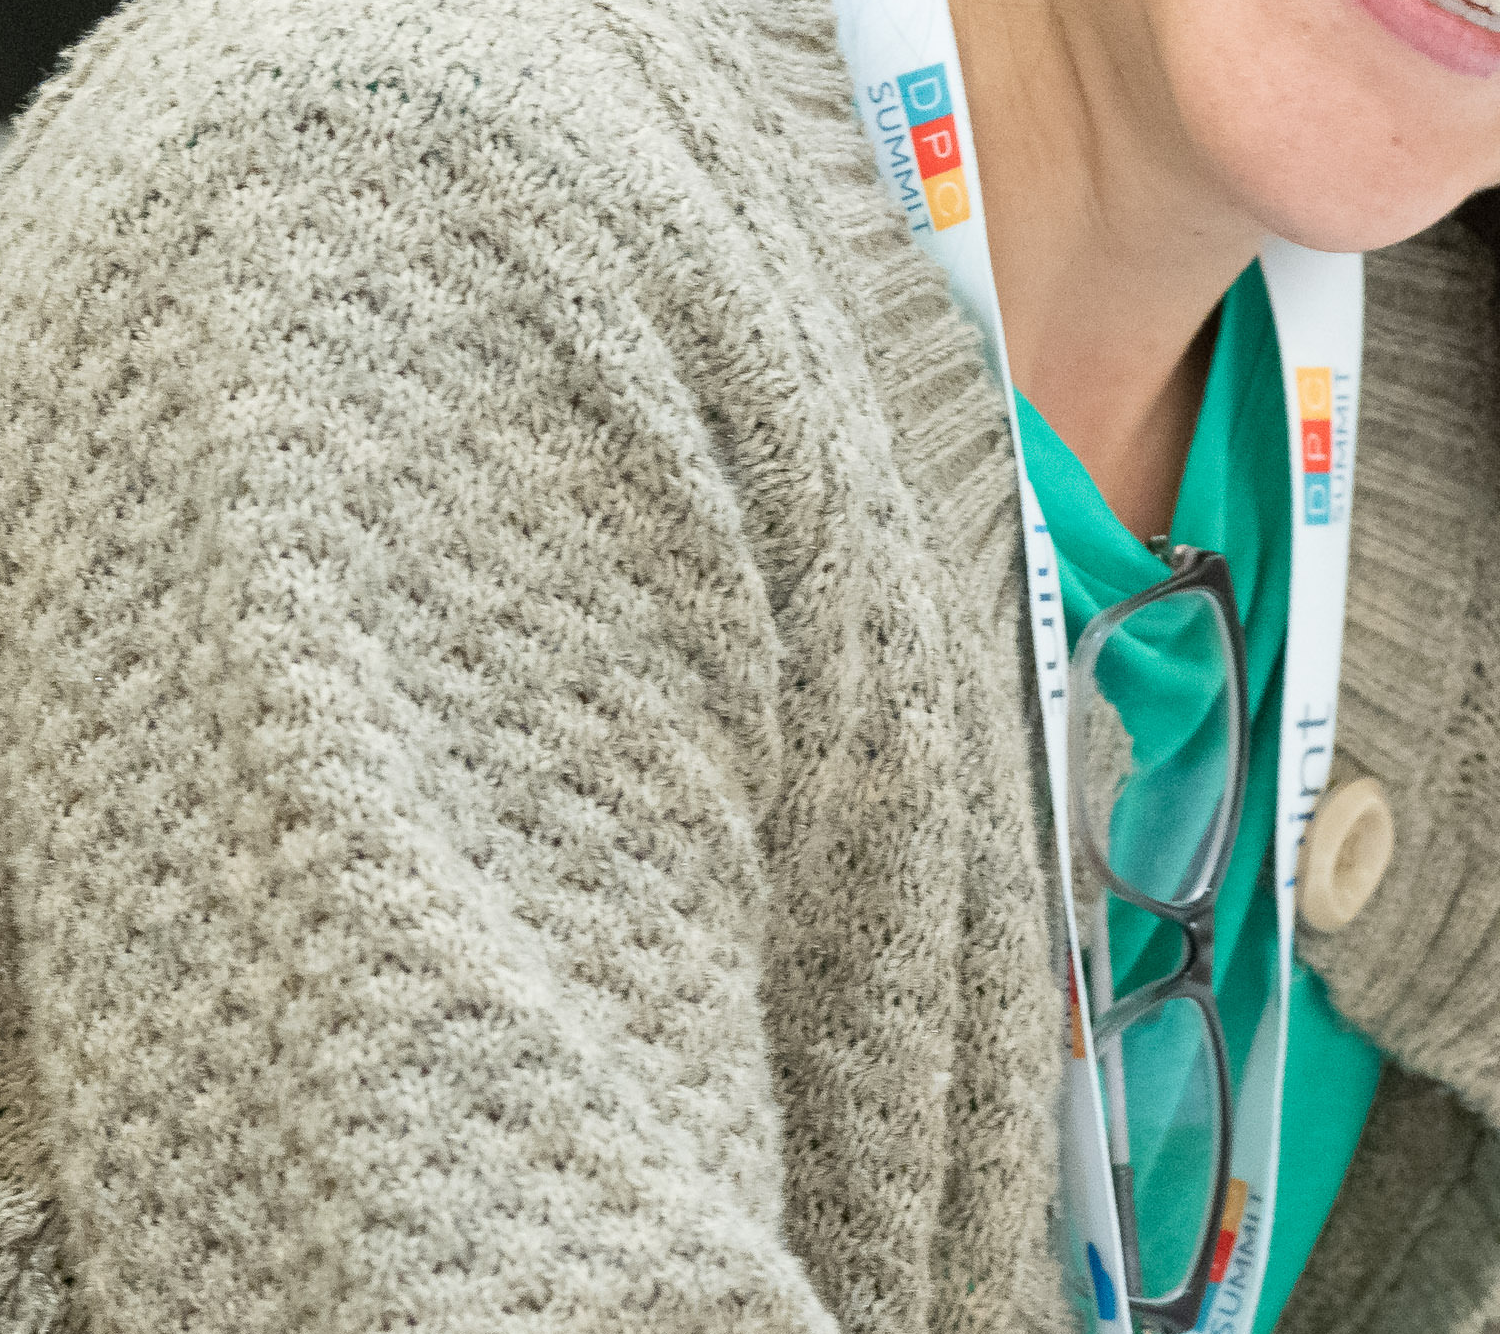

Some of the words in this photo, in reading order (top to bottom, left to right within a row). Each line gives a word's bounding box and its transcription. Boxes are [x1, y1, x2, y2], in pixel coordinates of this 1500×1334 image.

[867, 80, 933, 235] SUMMIT
[907, 75, 964, 218] DPC
[1332, 370, 1351, 523] SUMMIT
